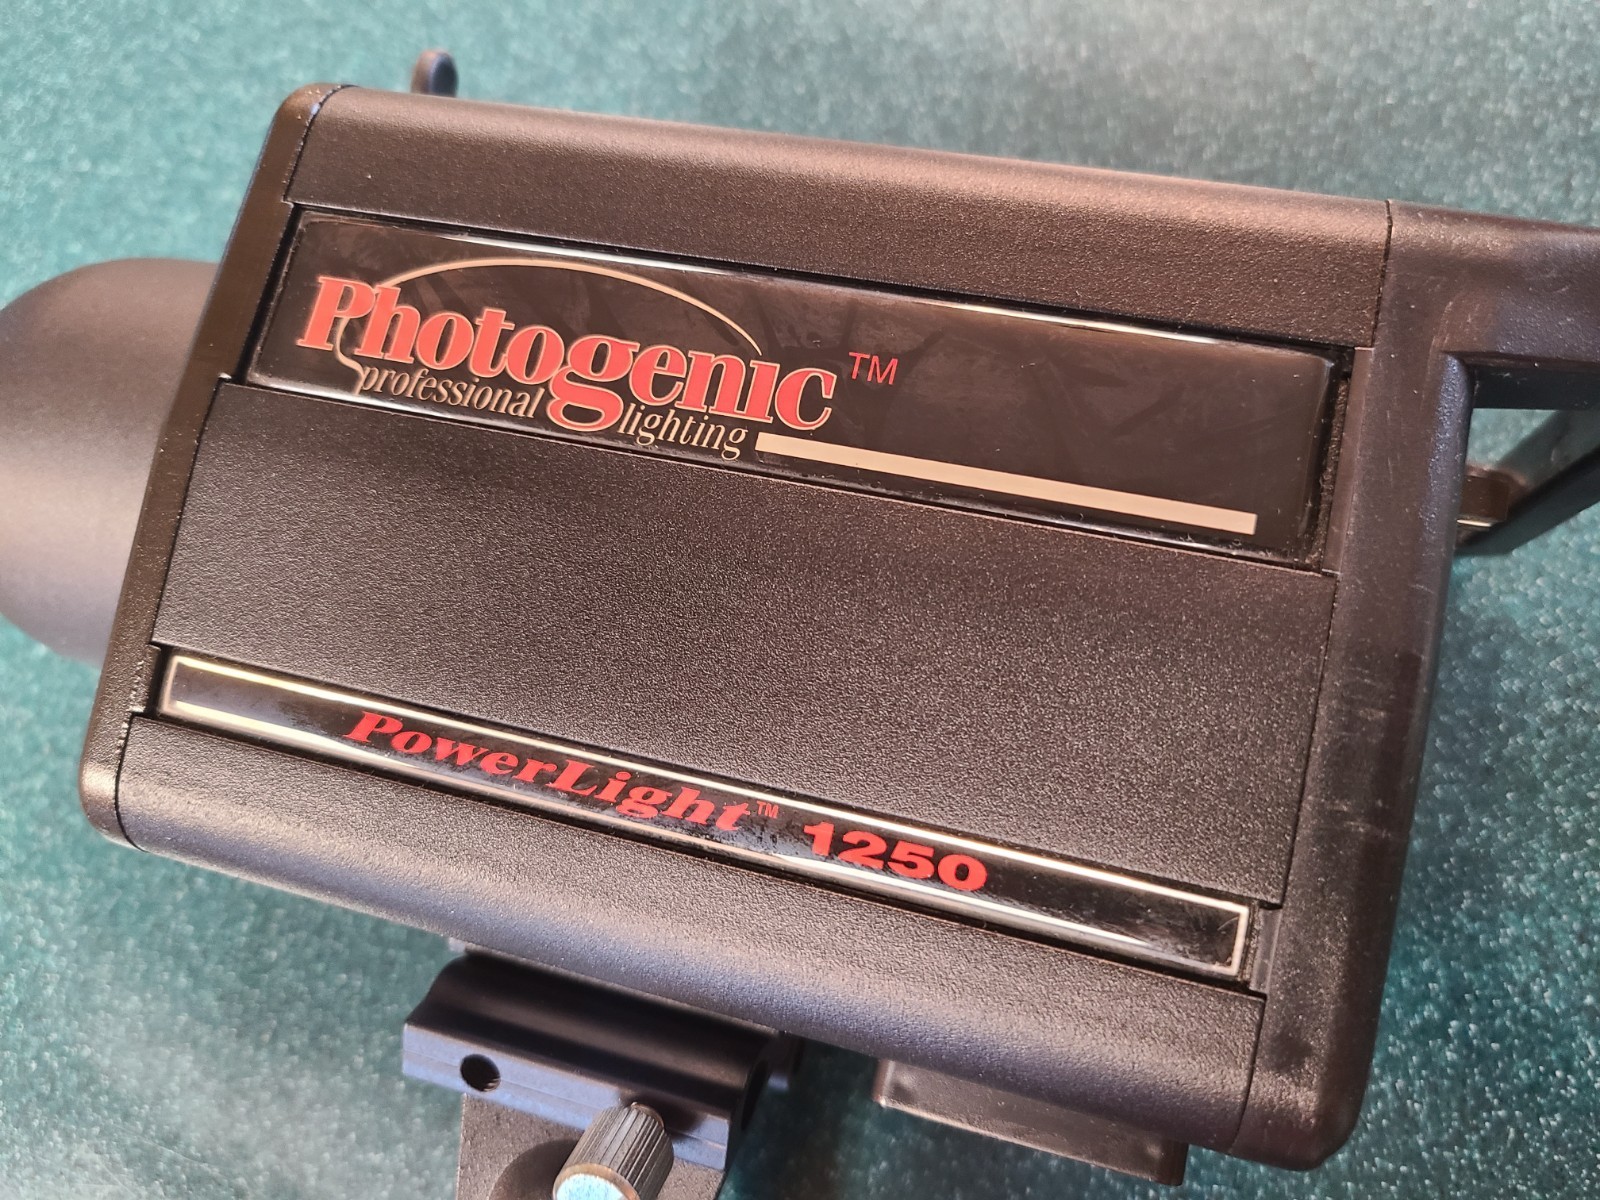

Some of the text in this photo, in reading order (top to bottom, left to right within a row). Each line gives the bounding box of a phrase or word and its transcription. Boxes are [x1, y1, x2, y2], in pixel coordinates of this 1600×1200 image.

[296, 275, 838, 432] Photogenic
[356, 364, 749, 461] professional lighting
[342, 711, 751, 833] PowerLight
[802, 821, 988, 893] 1250
